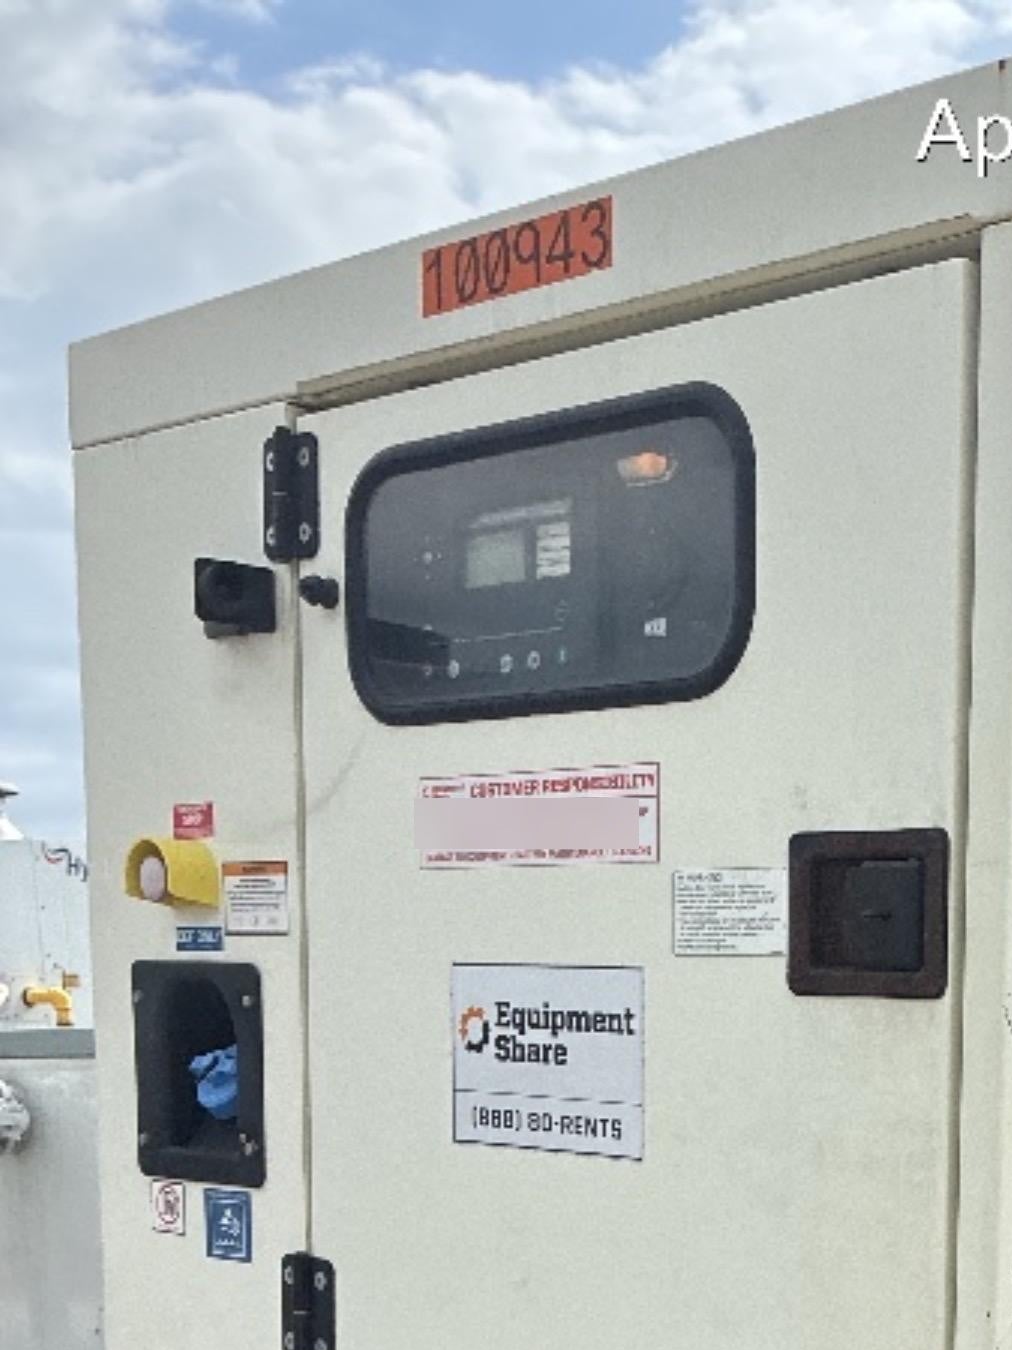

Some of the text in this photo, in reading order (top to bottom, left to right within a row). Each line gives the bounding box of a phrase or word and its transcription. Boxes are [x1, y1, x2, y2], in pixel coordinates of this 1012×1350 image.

[426, 200, 610, 310] 100943
[494, 1001, 635, 1038] Equipment
[494, 1034, 568, 1065] Share
[472, 1105, 522, 1132] (888)
